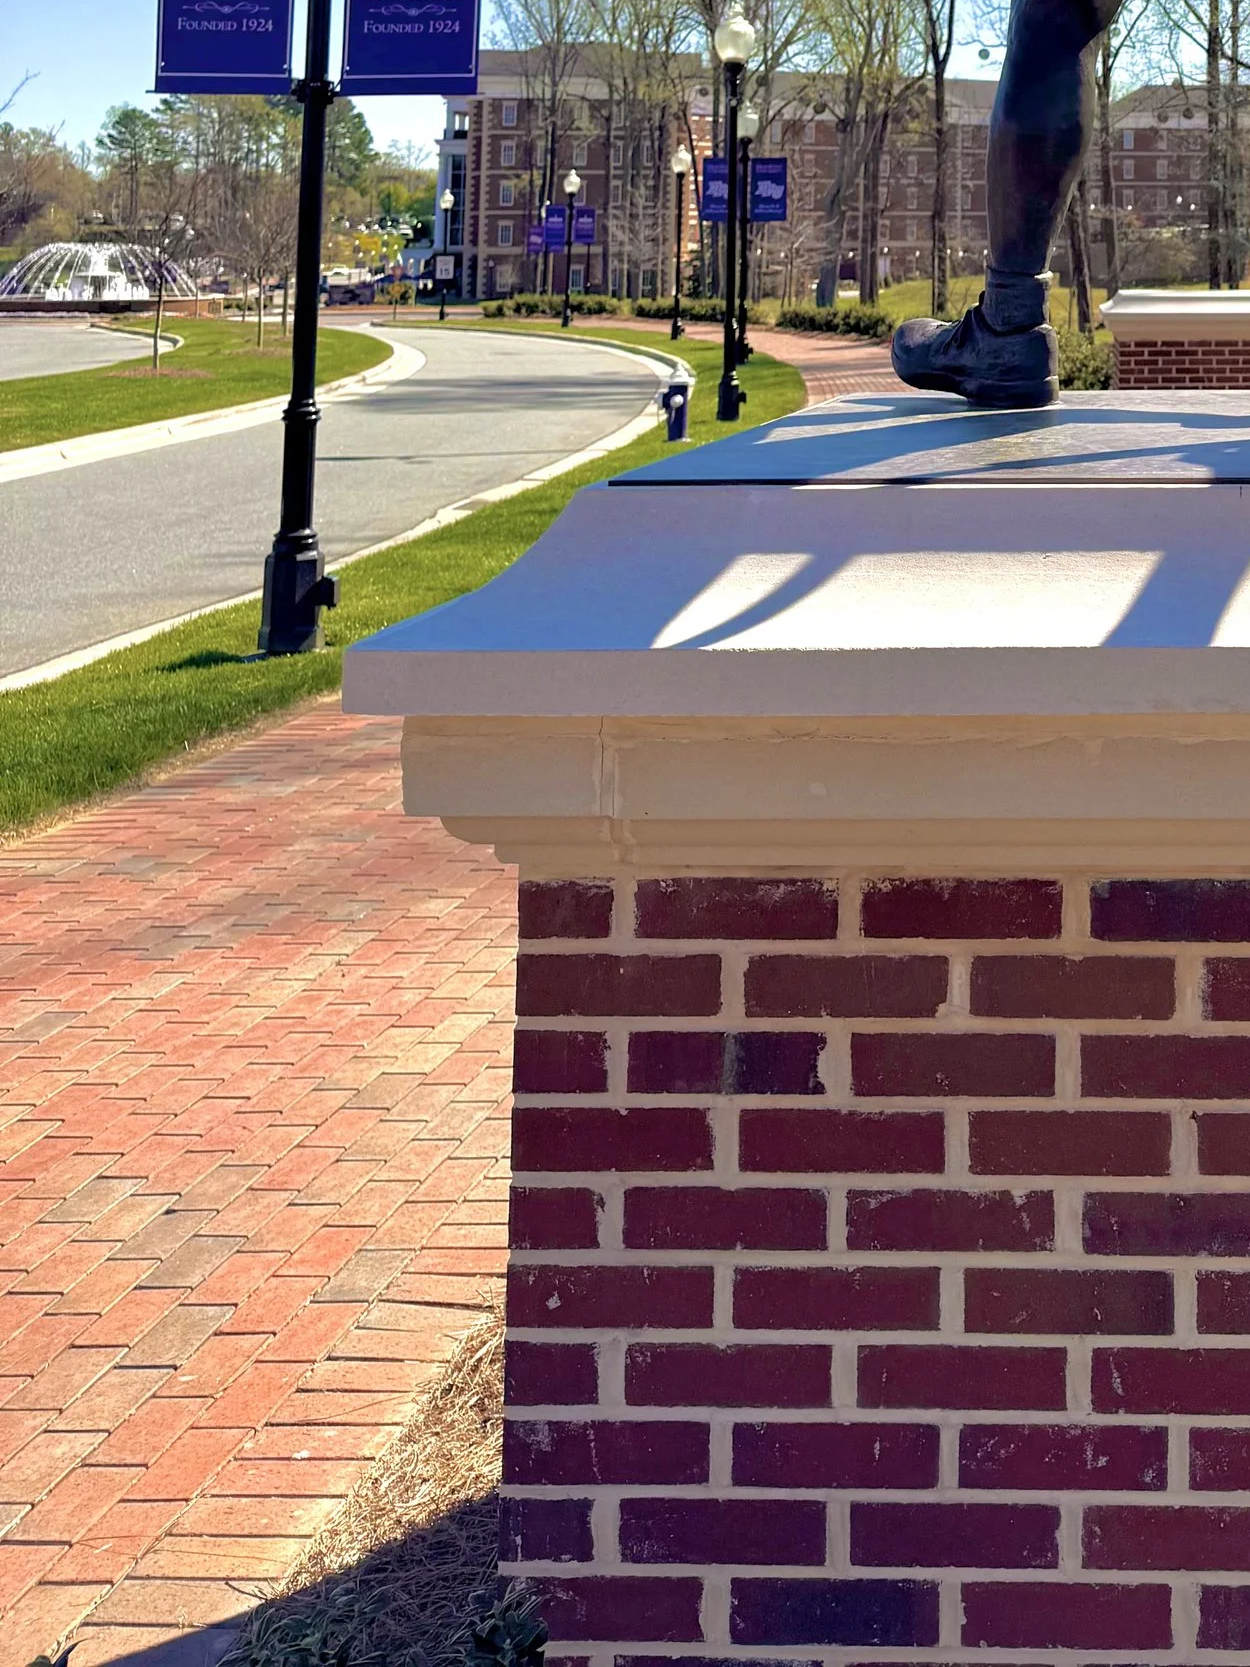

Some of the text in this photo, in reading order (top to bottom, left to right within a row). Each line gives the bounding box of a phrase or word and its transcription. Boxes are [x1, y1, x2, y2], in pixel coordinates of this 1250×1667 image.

[178, 17, 273, 32] FOUNDED 1924
[364, 20, 460, 33] FOUNDED 1924
